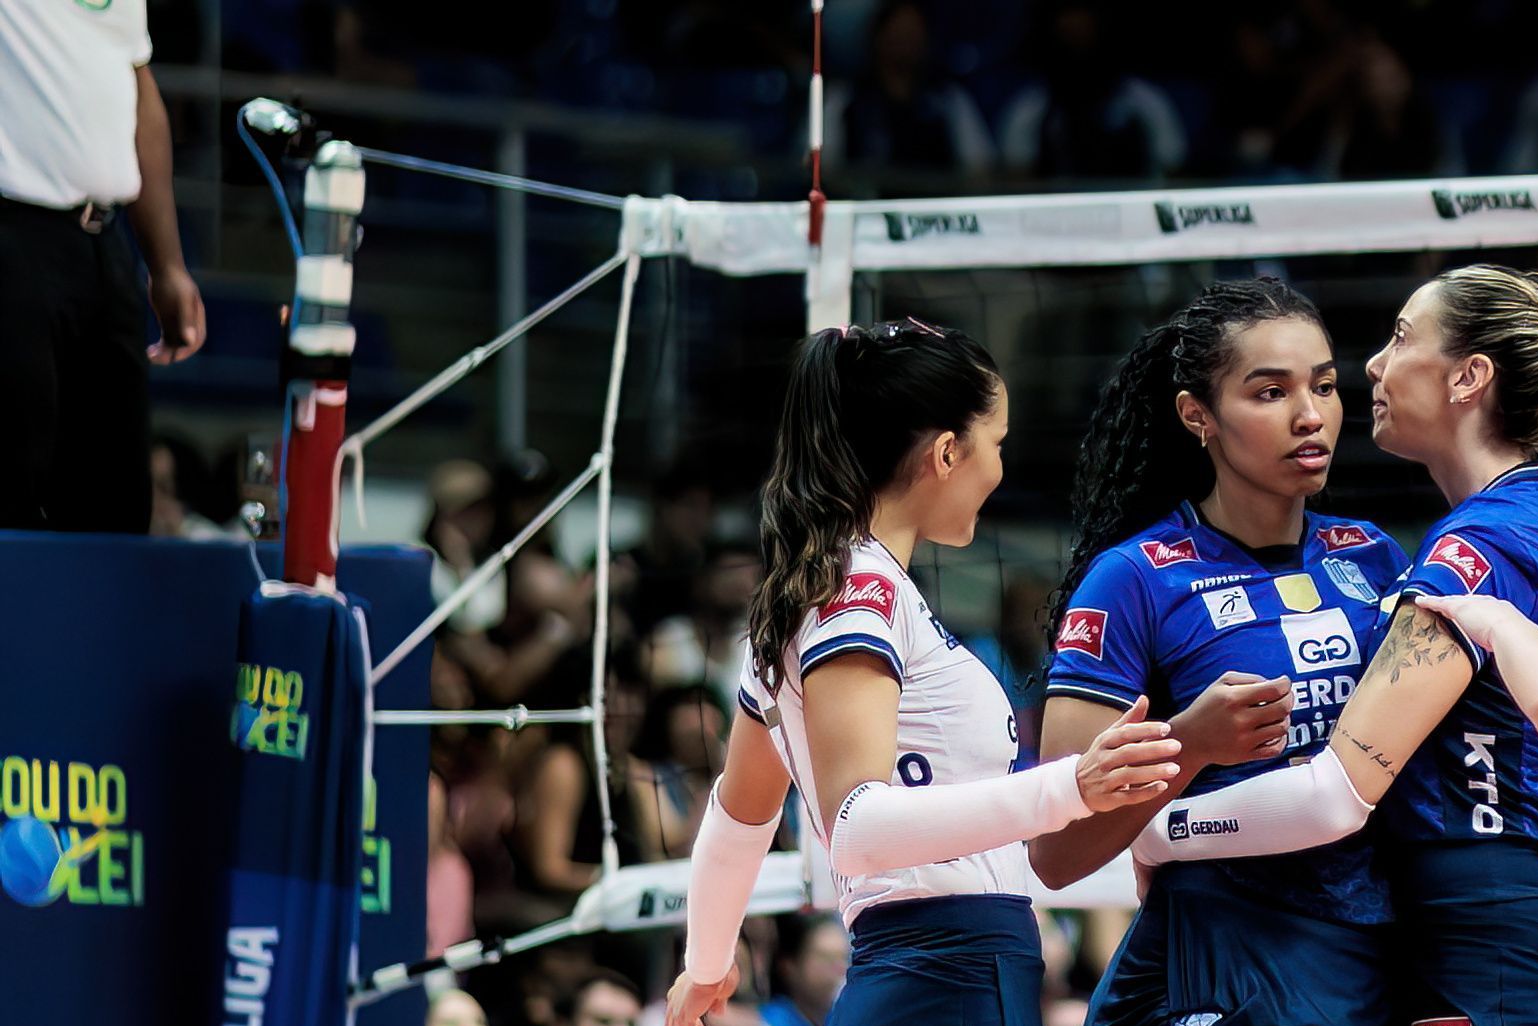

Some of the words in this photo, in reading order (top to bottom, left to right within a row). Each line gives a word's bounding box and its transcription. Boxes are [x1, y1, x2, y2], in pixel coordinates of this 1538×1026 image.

[1435, 541, 1476, 580] Melitta
[0, 755, 61, 823] OU
[68, 761, 126, 826] DO
[1463, 731, 1504, 835] KTO
[1190, 818, 1240, 836] GERDAU
